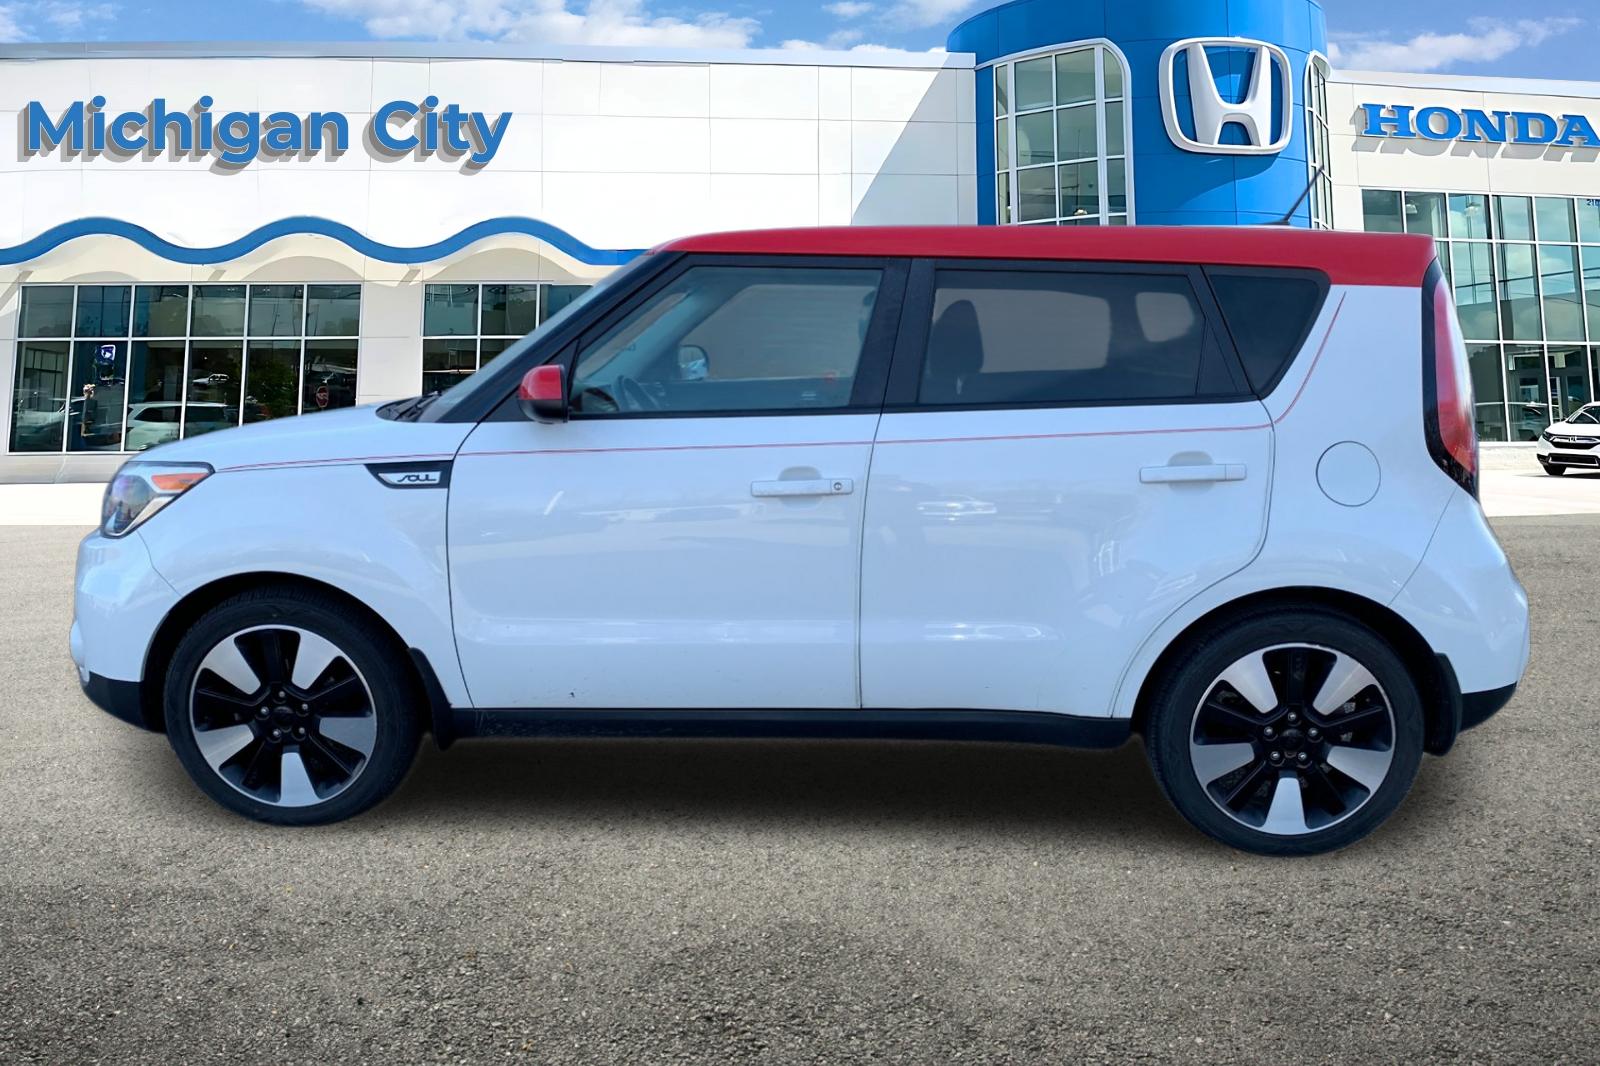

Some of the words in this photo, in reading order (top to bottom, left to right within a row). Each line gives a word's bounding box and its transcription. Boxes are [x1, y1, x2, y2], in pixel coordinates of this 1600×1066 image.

[27, 95, 349, 164] Michigan
[373, 95, 513, 164] City
[1361, 103, 1600, 148] HONDA
